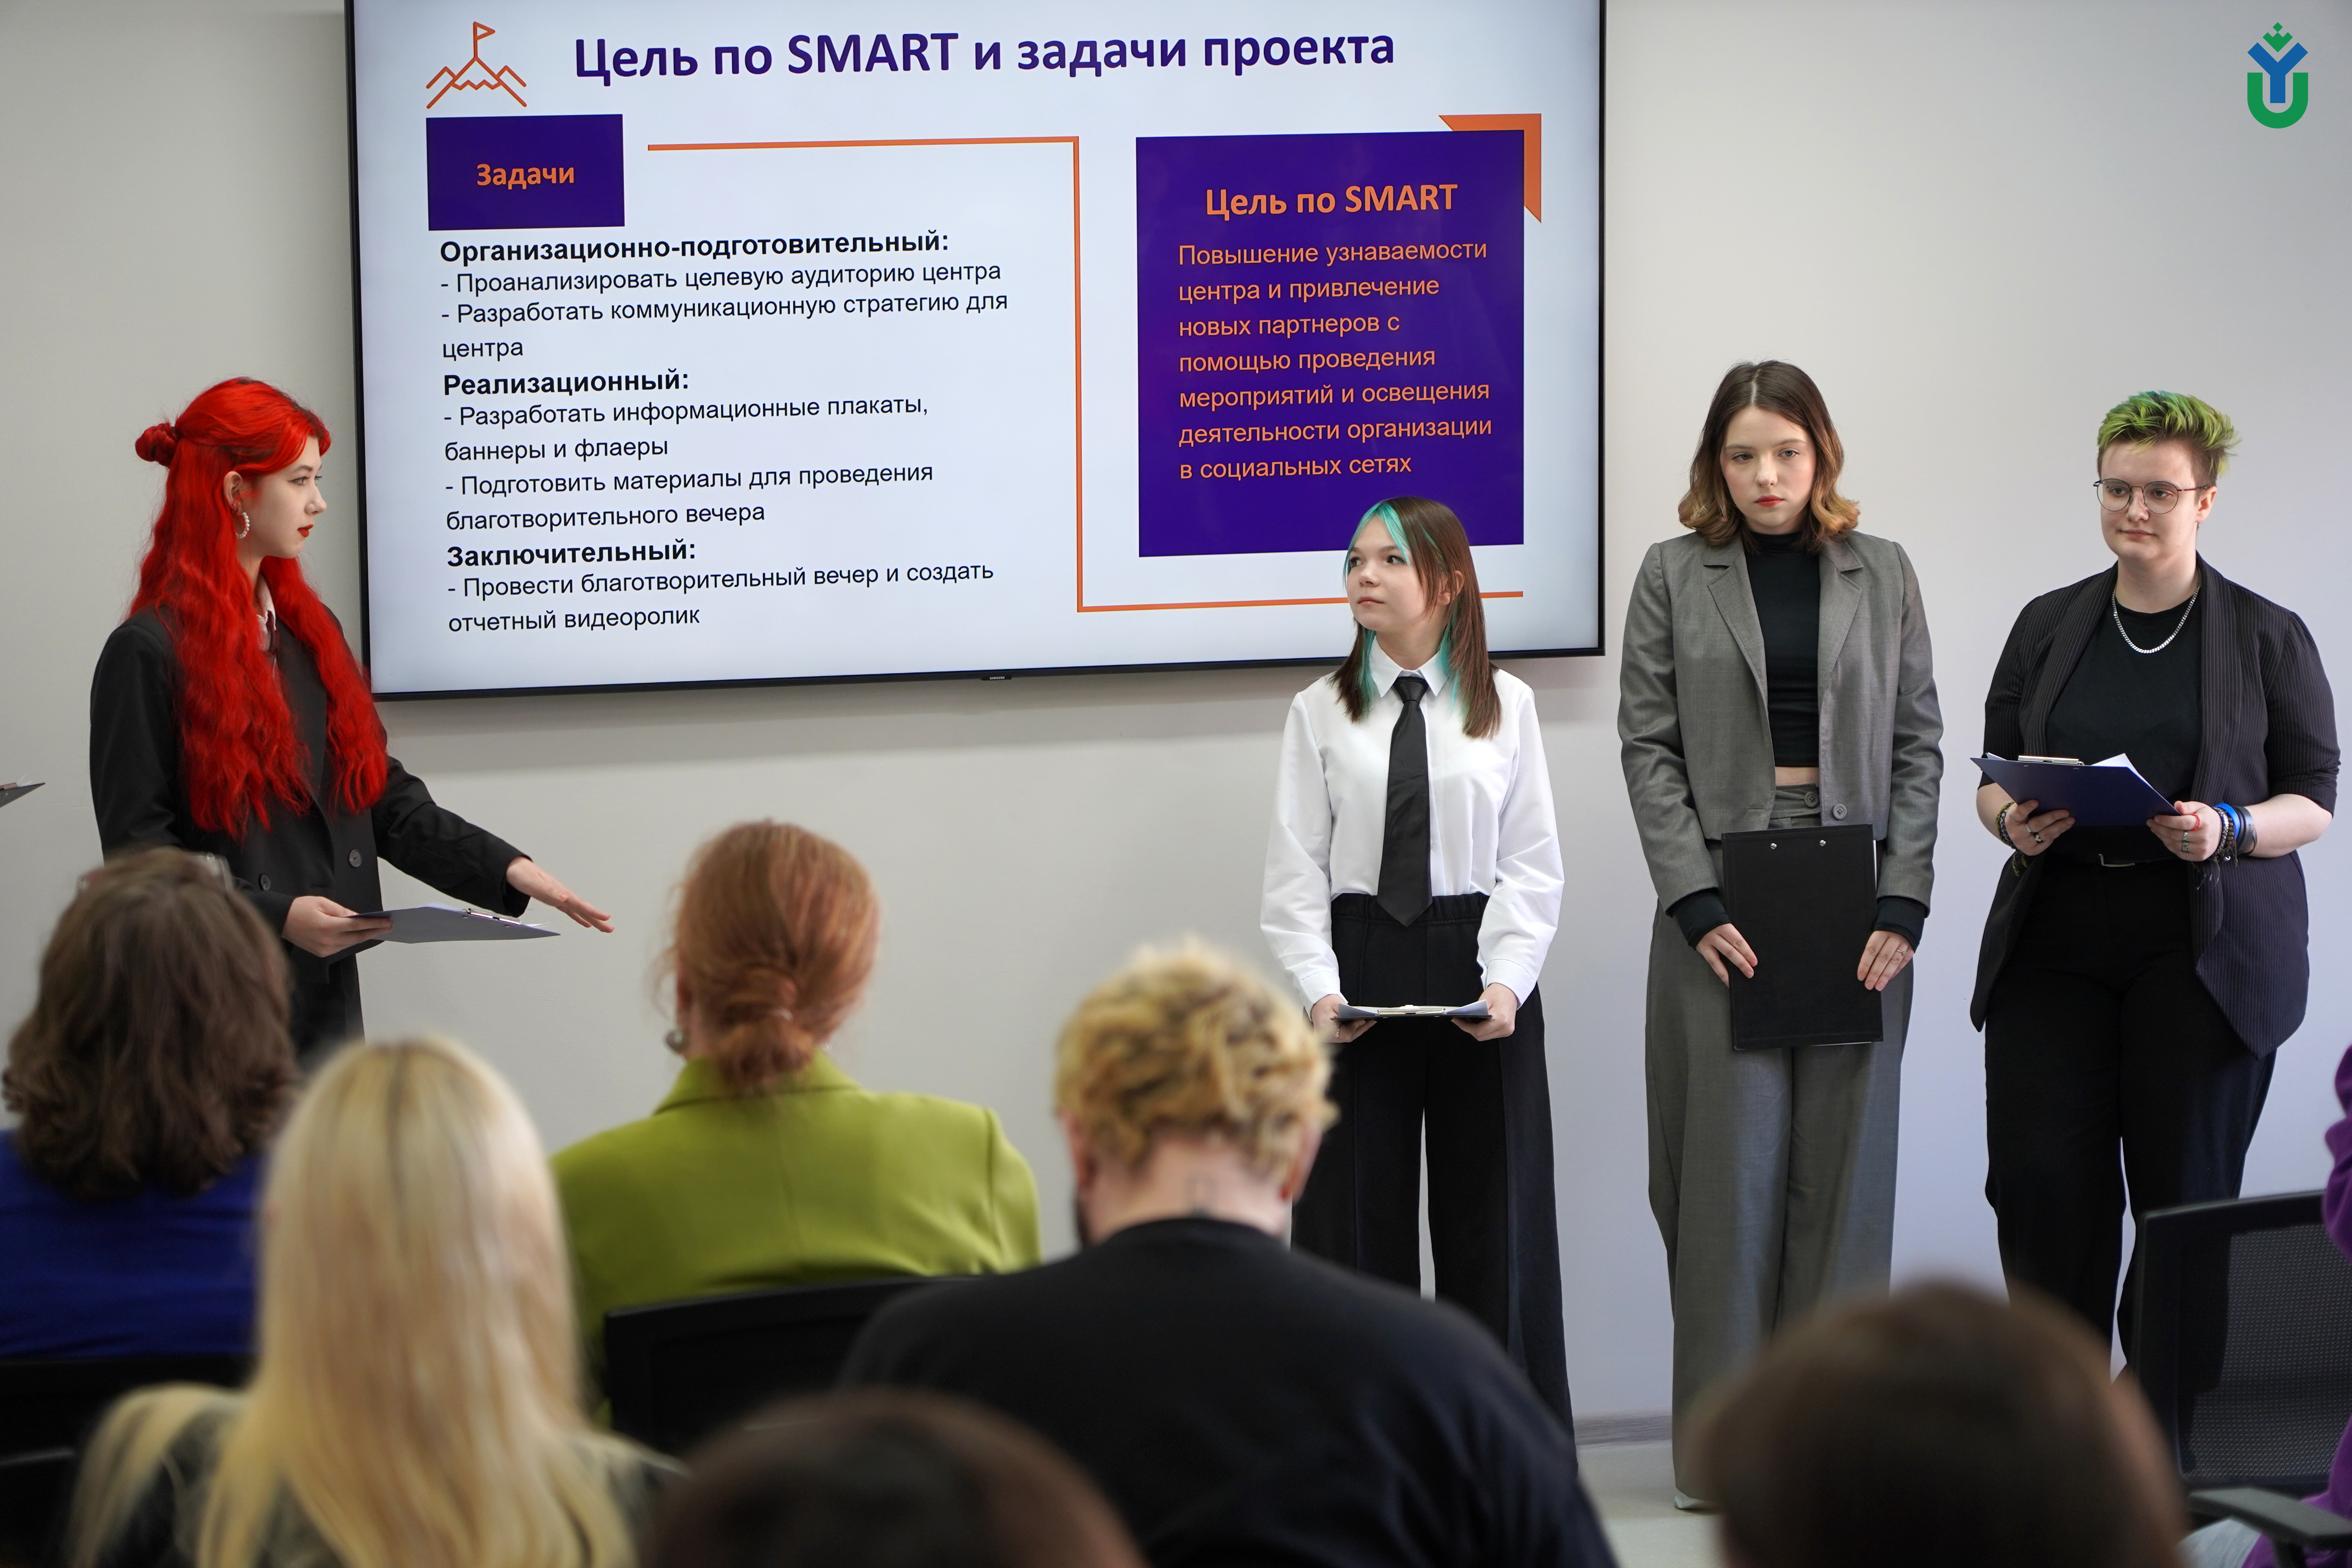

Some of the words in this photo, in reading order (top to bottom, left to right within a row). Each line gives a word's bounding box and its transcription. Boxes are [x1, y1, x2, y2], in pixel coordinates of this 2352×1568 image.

[576, 39, 698, 87] Цель
[715, 45, 772, 74] по
[788, 33, 958, 74] SMART
[975, 42, 1000, 70] и
[1018, 39, 1186, 78] задачи
[1205, 35, 1393, 76] проекта
[477, 164, 574, 190] Задачи
[1207, 189, 1287, 221] Цель
[1298, 193, 1335, 213] по
[1345, 184, 1458, 212] SMART
[441, 229, 947, 267] Организационно-подготовительный:
[1180, 245, 1318, 265] Повышение
[1326, 243, 1486, 267] узнаваемости
[457, 273, 677, 297] Проанализировать
[686, 270, 783, 290] целевую
[791, 267, 915, 289] аудиторию
[923, 265, 1001, 285] центра
[1180, 285, 1260, 305] центра
[1269, 284, 1281, 298] и
[1290, 280, 1439, 303] привлечение
[458, 302, 603, 327] Разработать
[612, 299, 835, 323] коммуникационную
[844, 296, 959, 318] стратегию
[966, 295, 1007, 314] для
[1180, 320, 1251, 336] новых
[1259, 317, 1379, 339] партнеров
[1388, 316, 1399, 330] с
[443, 342, 523, 361] центра
[1180, 355, 1290, 374] помощью
[1299, 350, 1435, 373] проведения
[444, 368, 688, 396] Реализационный:
[1180, 384, 1333, 412] мероприятий
[1342, 388, 1354, 403] и
[1362, 385, 1489, 404] освещения
[461, 404, 605, 430] Разработать
[613, 401, 820, 425] информационные
[828, 399, 927, 415] плакаты,
[1179, 425, 1339, 447] деятельности
[1348, 420, 1491, 443] организации
[445, 441, 545, 464] баннеры
[554, 443, 566, 458] и
[575, 438, 668, 462] флаеры
[462, 476, 606, 498] Подготовить
[614, 472, 741, 494] материалы
[749, 471, 790, 490] для
[800, 466, 932, 489] проведения
[1181, 465, 1192, 479] в
[1201, 460, 1342, 481] социальных
[1349, 457, 1412, 474] сетях
[447, 509, 678, 532] благотворительного
[686, 506, 764, 526] вечера
[447, 538, 695, 567] Заключительный:
[464, 578, 573, 601] Провести
[581, 567, 805, 594] благотворительный
[814, 569, 878, 588] вечер
[887, 568, 898, 582] и
[907, 565, 993, 584] создать
[449, 610, 556, 632] отчетный
[565, 609, 700, 631] видеоролик
